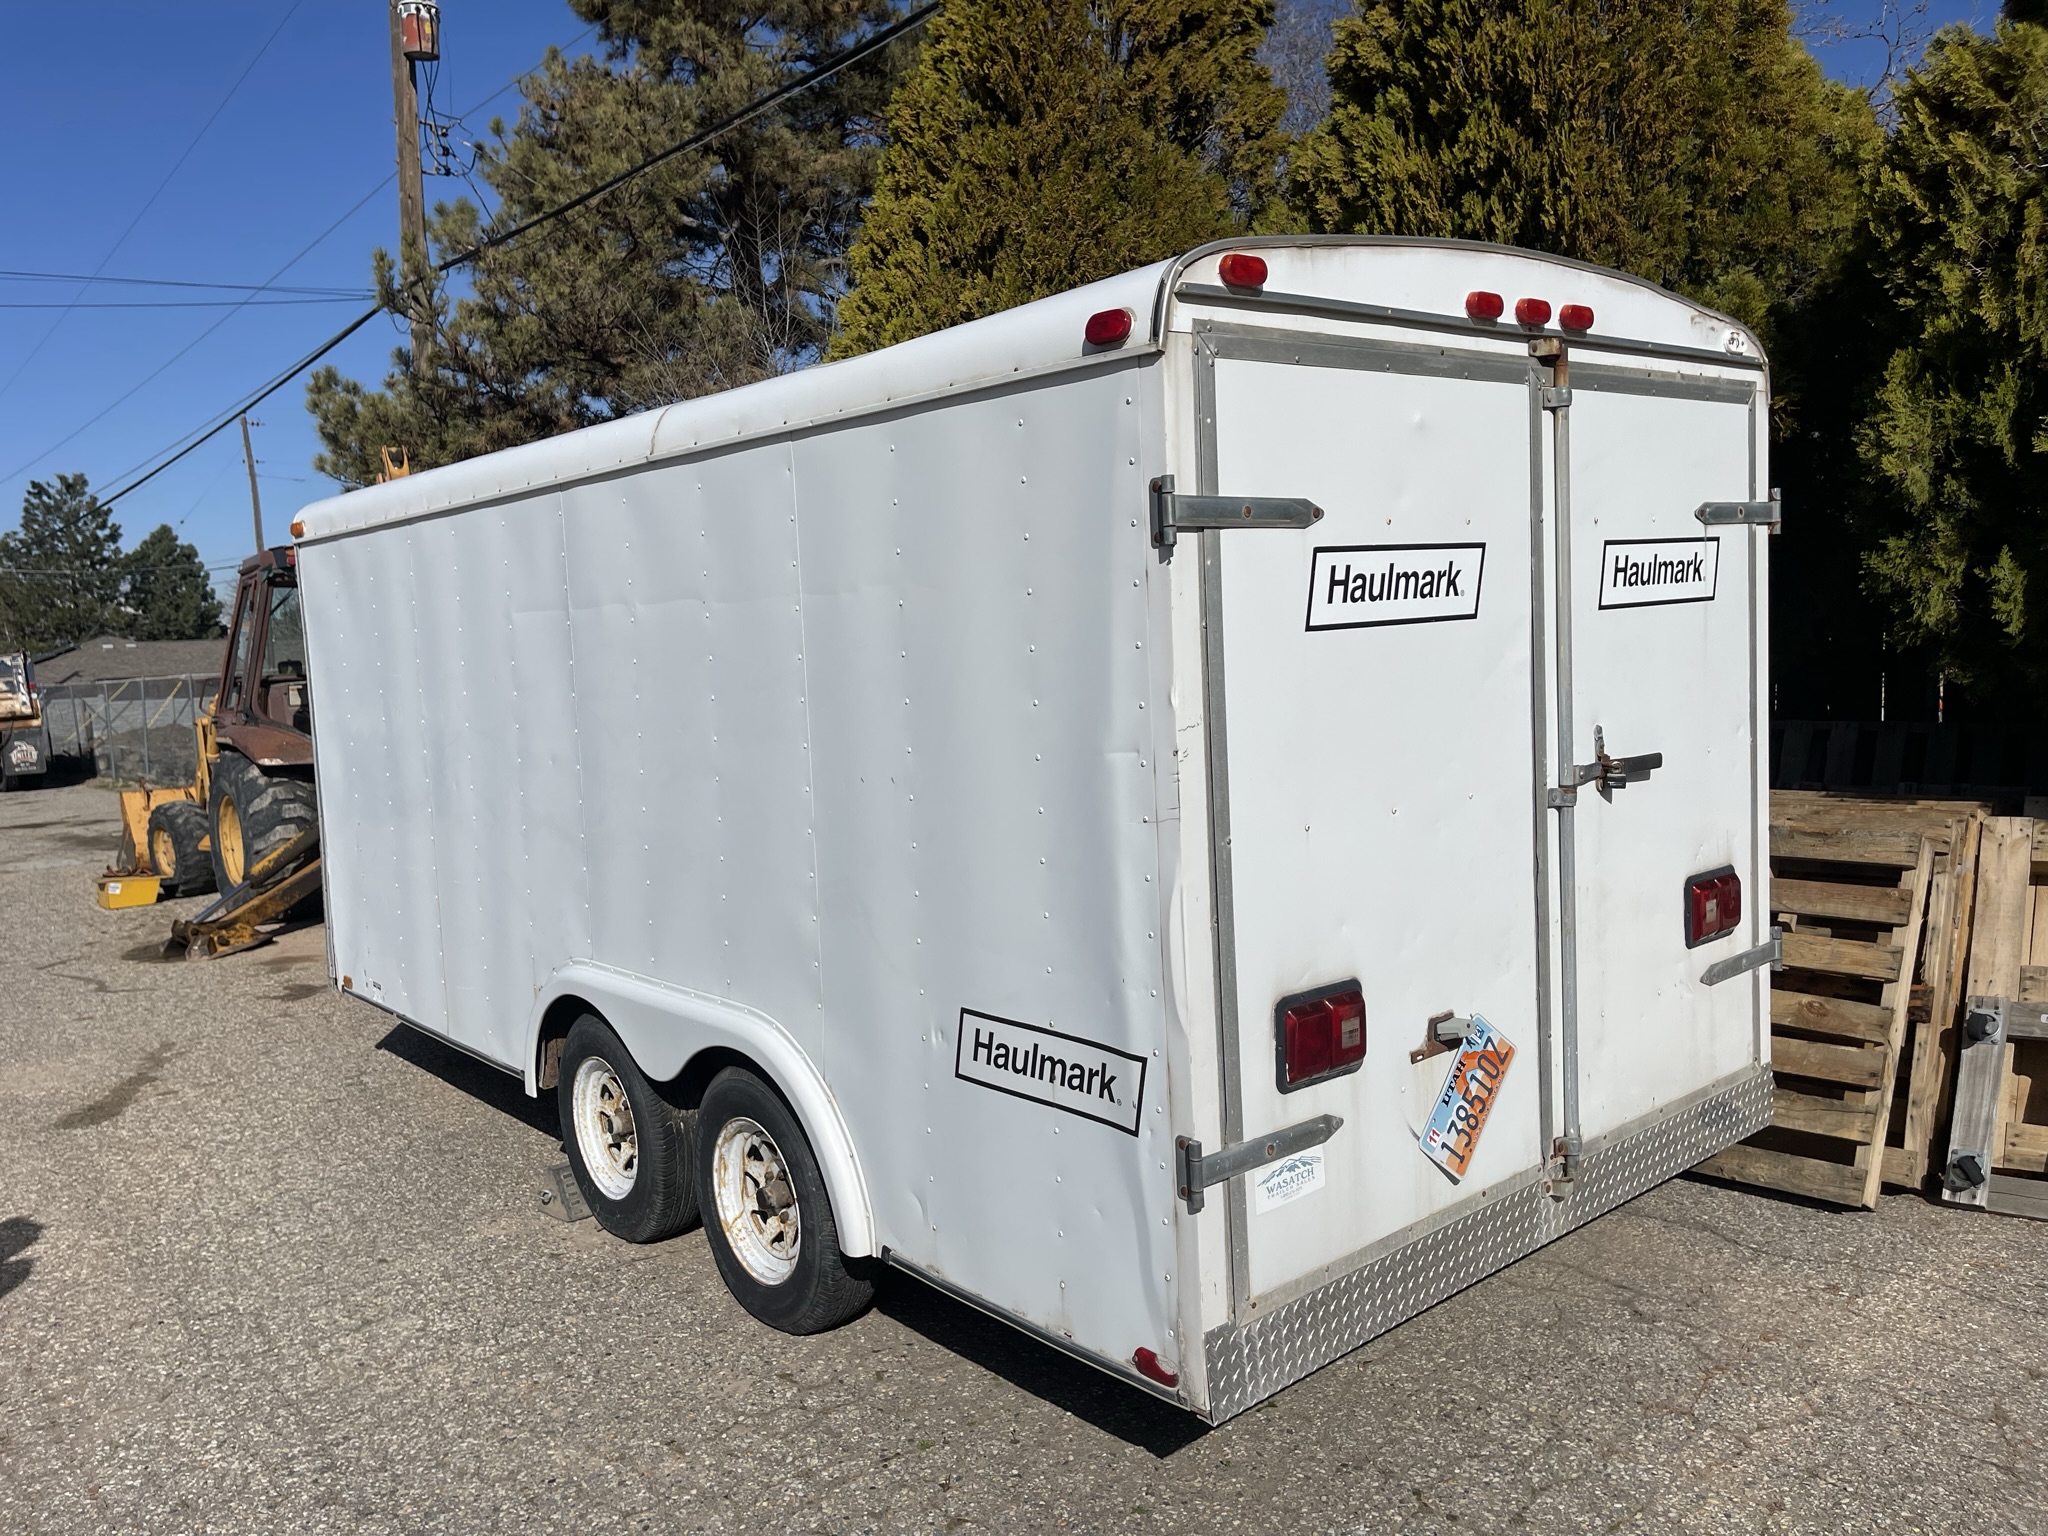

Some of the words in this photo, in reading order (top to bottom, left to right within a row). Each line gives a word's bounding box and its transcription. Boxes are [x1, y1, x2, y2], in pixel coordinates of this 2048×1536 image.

[1327, 560, 1462, 605] Haulmark
[1613, 551, 1704, 588] Haulmark
[973, 1027, 1118, 1105] Haulmark
[1441, 1060, 1466, 1108] UTAH
[1440, 1035, 1510, 1165] 138510Z
[1428, 1129, 1441, 1144] 11
[1266, 1167, 1314, 1195] WASATCH
[1296, 1176, 1316, 1186] SALES
